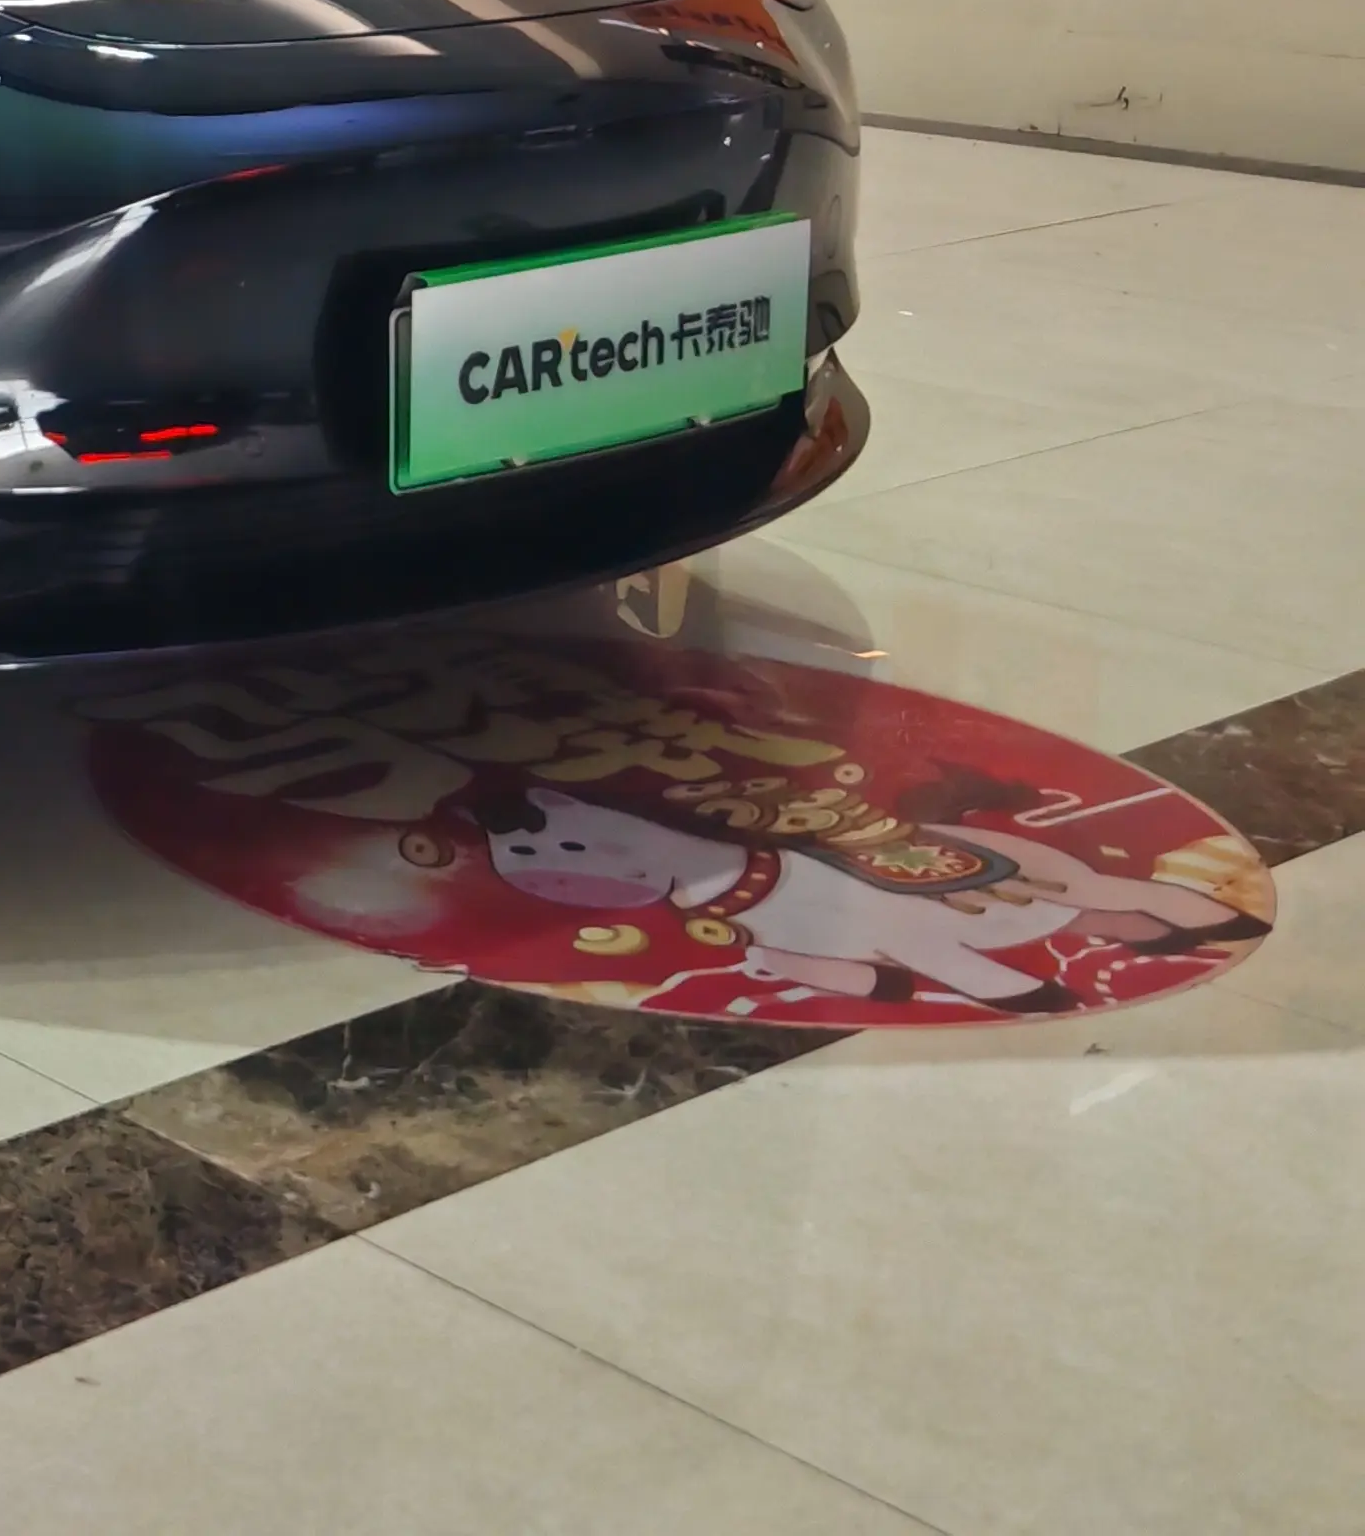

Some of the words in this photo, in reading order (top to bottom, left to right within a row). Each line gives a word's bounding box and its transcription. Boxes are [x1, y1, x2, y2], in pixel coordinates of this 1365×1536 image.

[458, 319, 665, 406] CARtech
[671, 295, 771, 361] 卡泰驰
